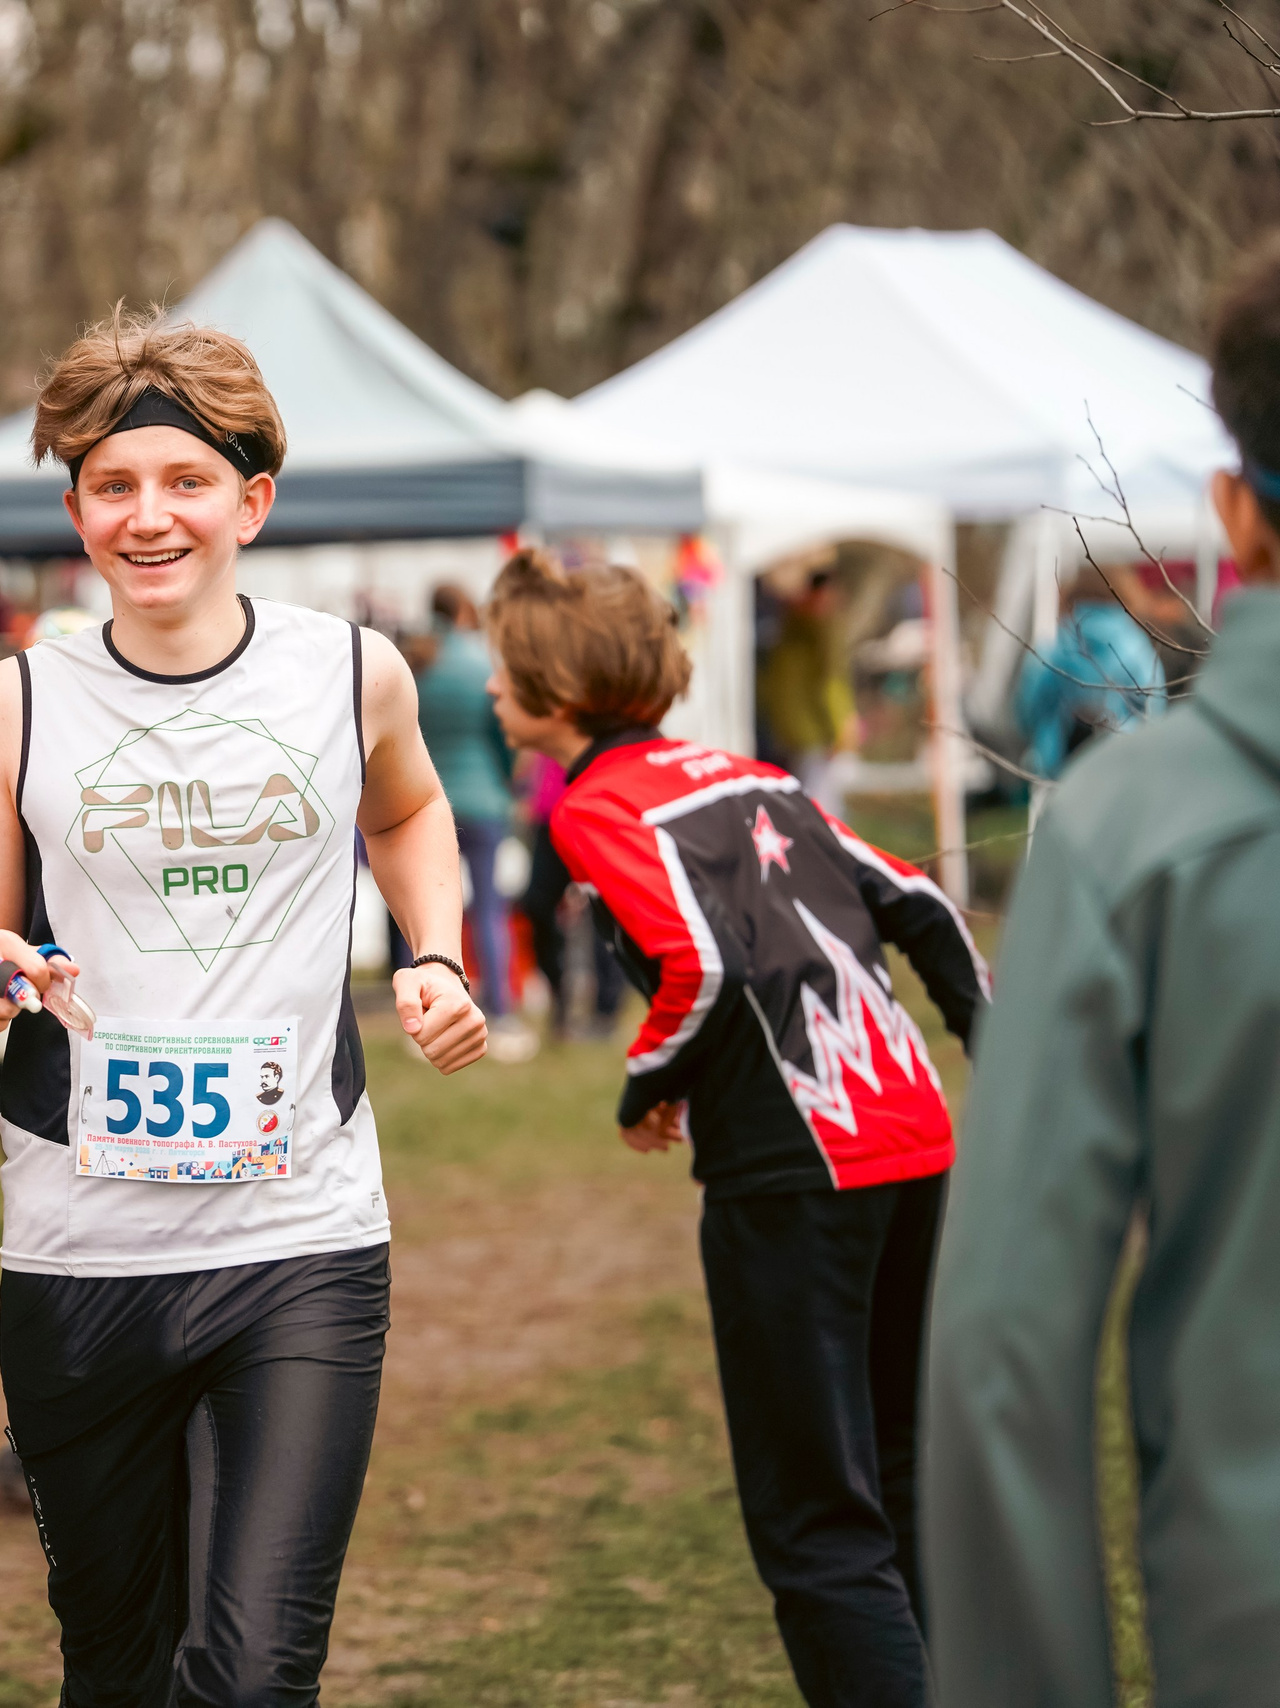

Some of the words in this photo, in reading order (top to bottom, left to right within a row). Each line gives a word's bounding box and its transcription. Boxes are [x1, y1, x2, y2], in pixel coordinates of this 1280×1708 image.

[80, 773, 320, 854] FILA
[162, 863, 249, 897] PRO
[93, 1031, 142, 1042] СЕРОССИЙСКИЕ
[144, 1035, 192, 1044] СПОРТИВНЫЕ
[194, 1036, 249, 1044] СОРЕВНОВАНИЯ
[105, 1042, 114, 1050] ПО
[115, 1043, 162, 1054] СПОРТИВНОМУ
[164, 1047, 233, 1055] ОРИЕНТИРОВАНИЮ
[105, 1058, 231, 1139] 535
[86, 1133, 115, 1143] Памяти
[117, 1137, 150, 1146] военного
[152, 1140, 195, 1149] топографа
[197, 1140, 205, 1148] А.
[208, 1140, 216, 1148] В.
[218, 1140, 258, 1149] Пастухова
